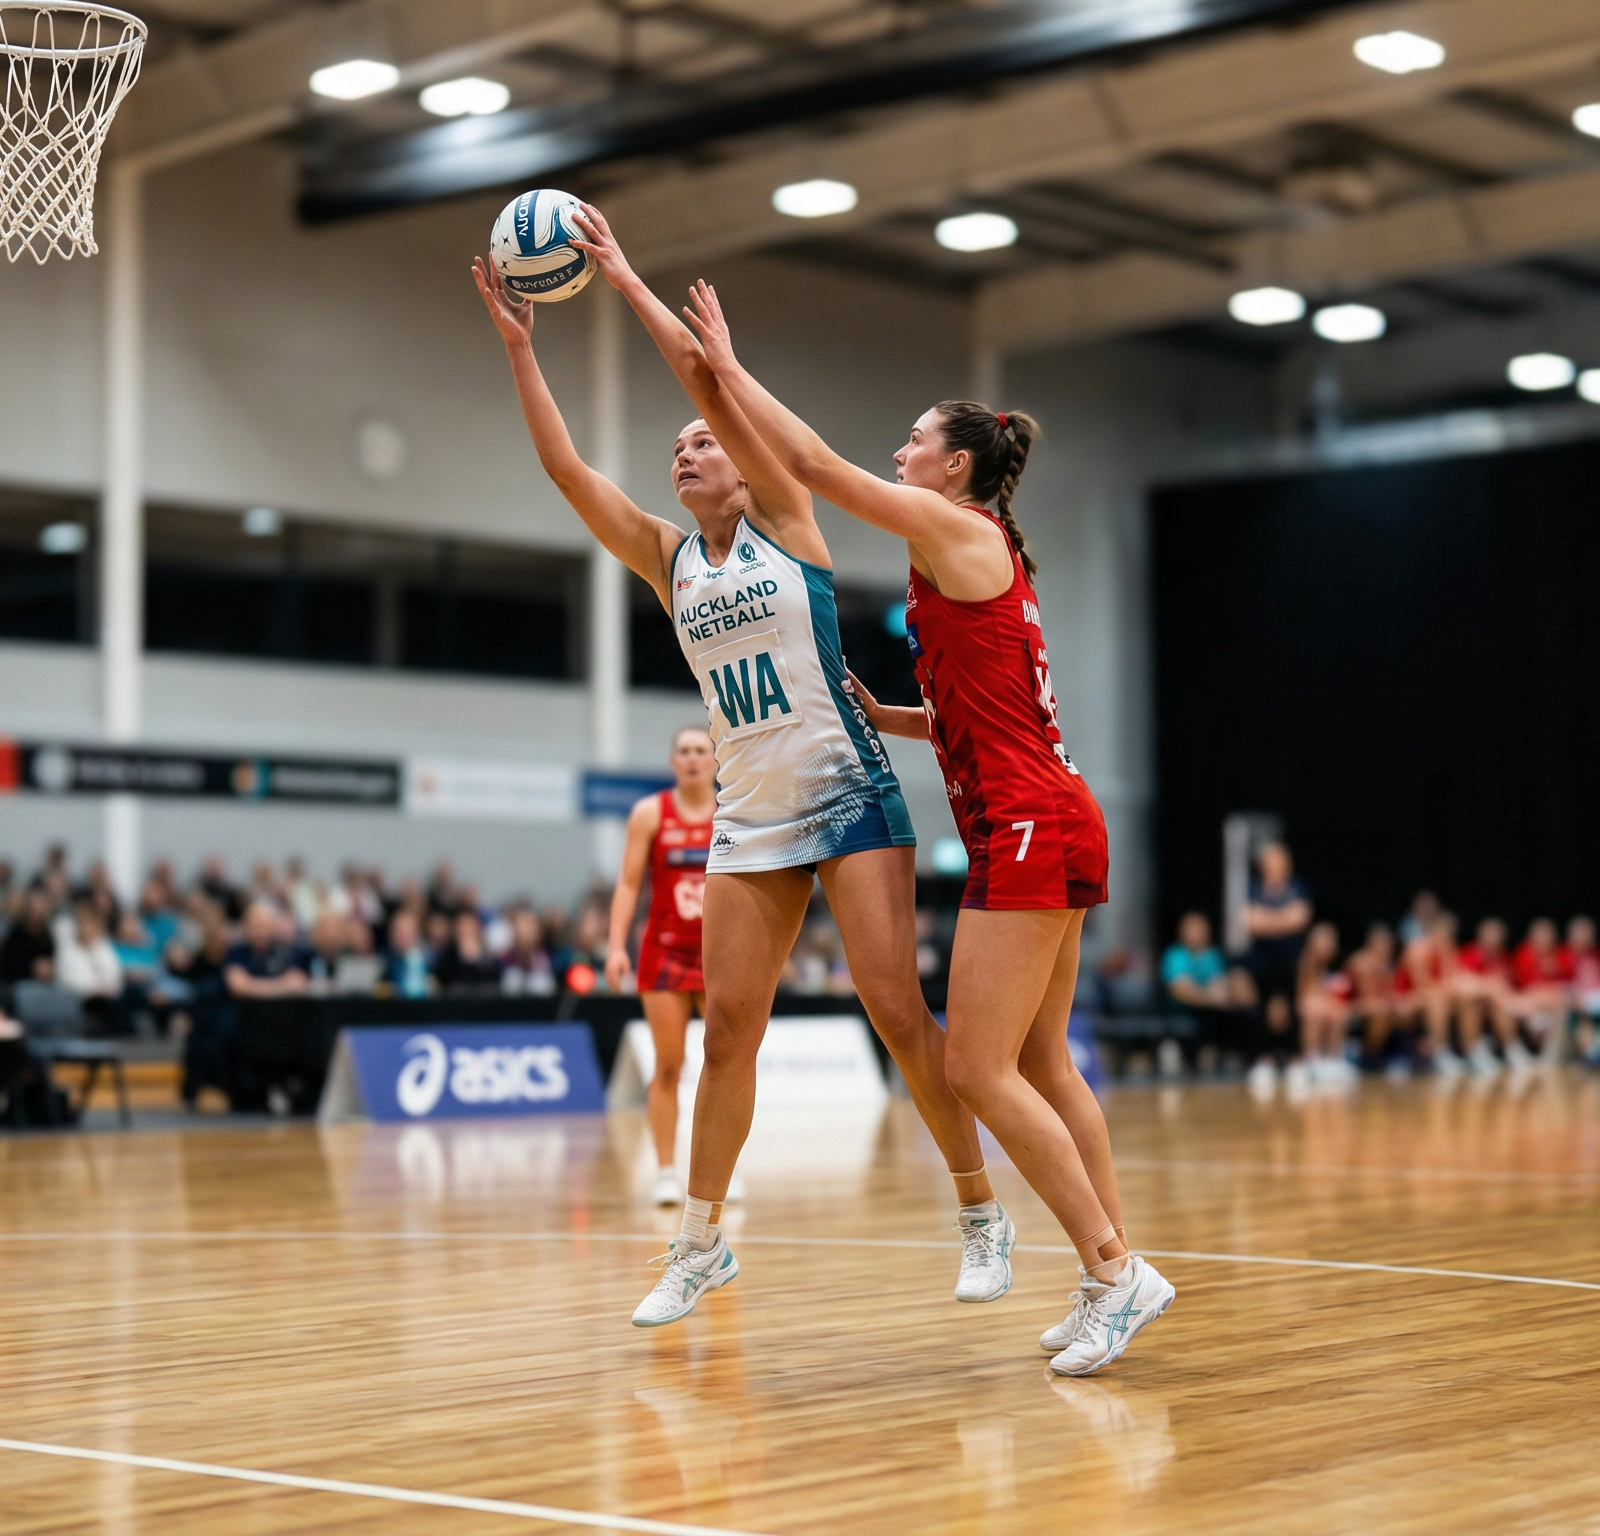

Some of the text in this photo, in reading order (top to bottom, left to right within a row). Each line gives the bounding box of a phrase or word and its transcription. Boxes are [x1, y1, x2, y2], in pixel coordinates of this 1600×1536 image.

[680, 579, 778, 627] AUCKLAND
[687, 601, 776, 644] NETBALL
[708, 651, 792, 729] WA
[1011, 820, 1035, 862] 7
[450, 1045, 570, 1104] asics
